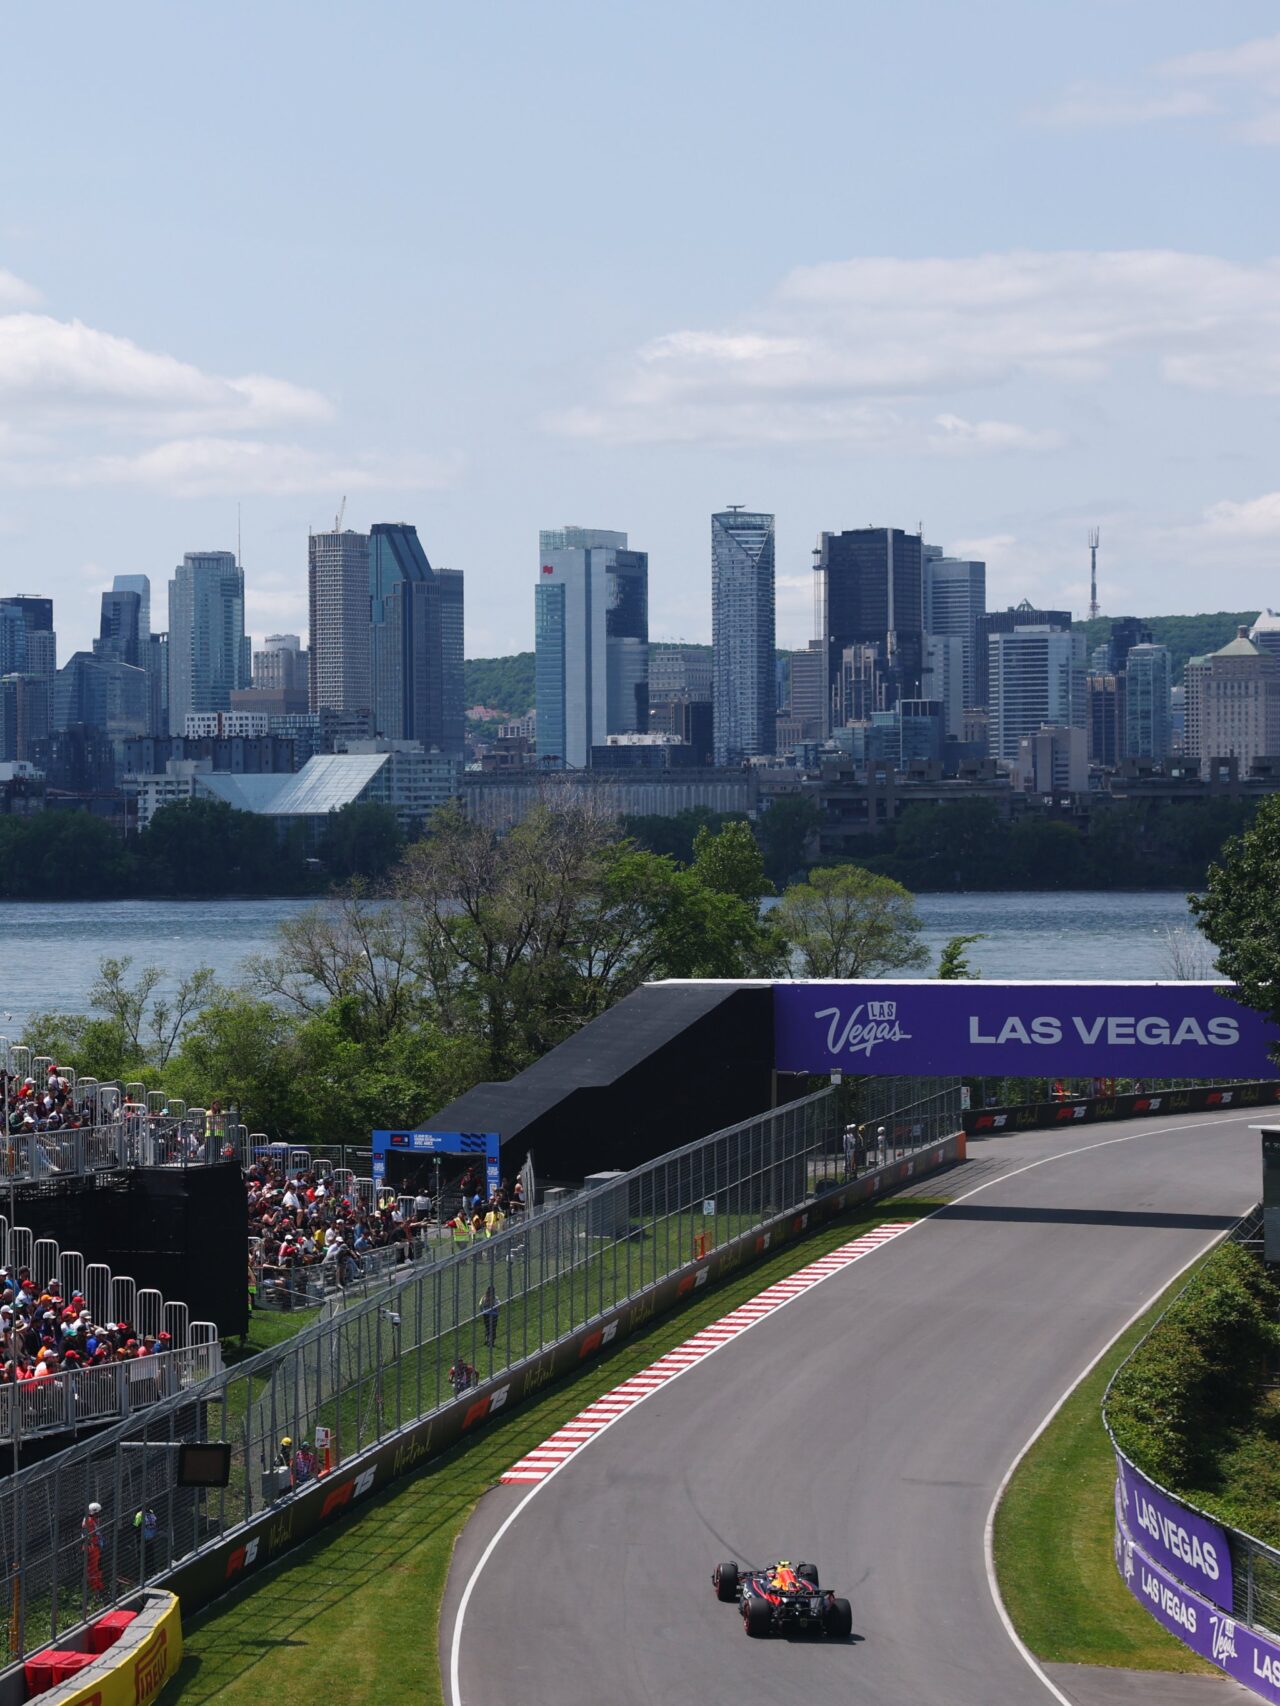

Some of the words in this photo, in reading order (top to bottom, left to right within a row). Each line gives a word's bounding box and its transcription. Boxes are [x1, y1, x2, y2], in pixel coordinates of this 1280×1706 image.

[814, 1004, 912, 1057] Vegas
[869, 1003, 895, 1019] LAS
[969, 1016, 1063, 1044] LAS
[1071, 1016, 1240, 1045] VEGAS
[1134, 1490, 1159, 1540] LAS
[1157, 1512, 1219, 1580] VEGAS
[1142, 1567, 1159, 1604] LAS
[1160, 1584, 1196, 1633] VEGAS
[1209, 1616, 1238, 1668] Vegas
